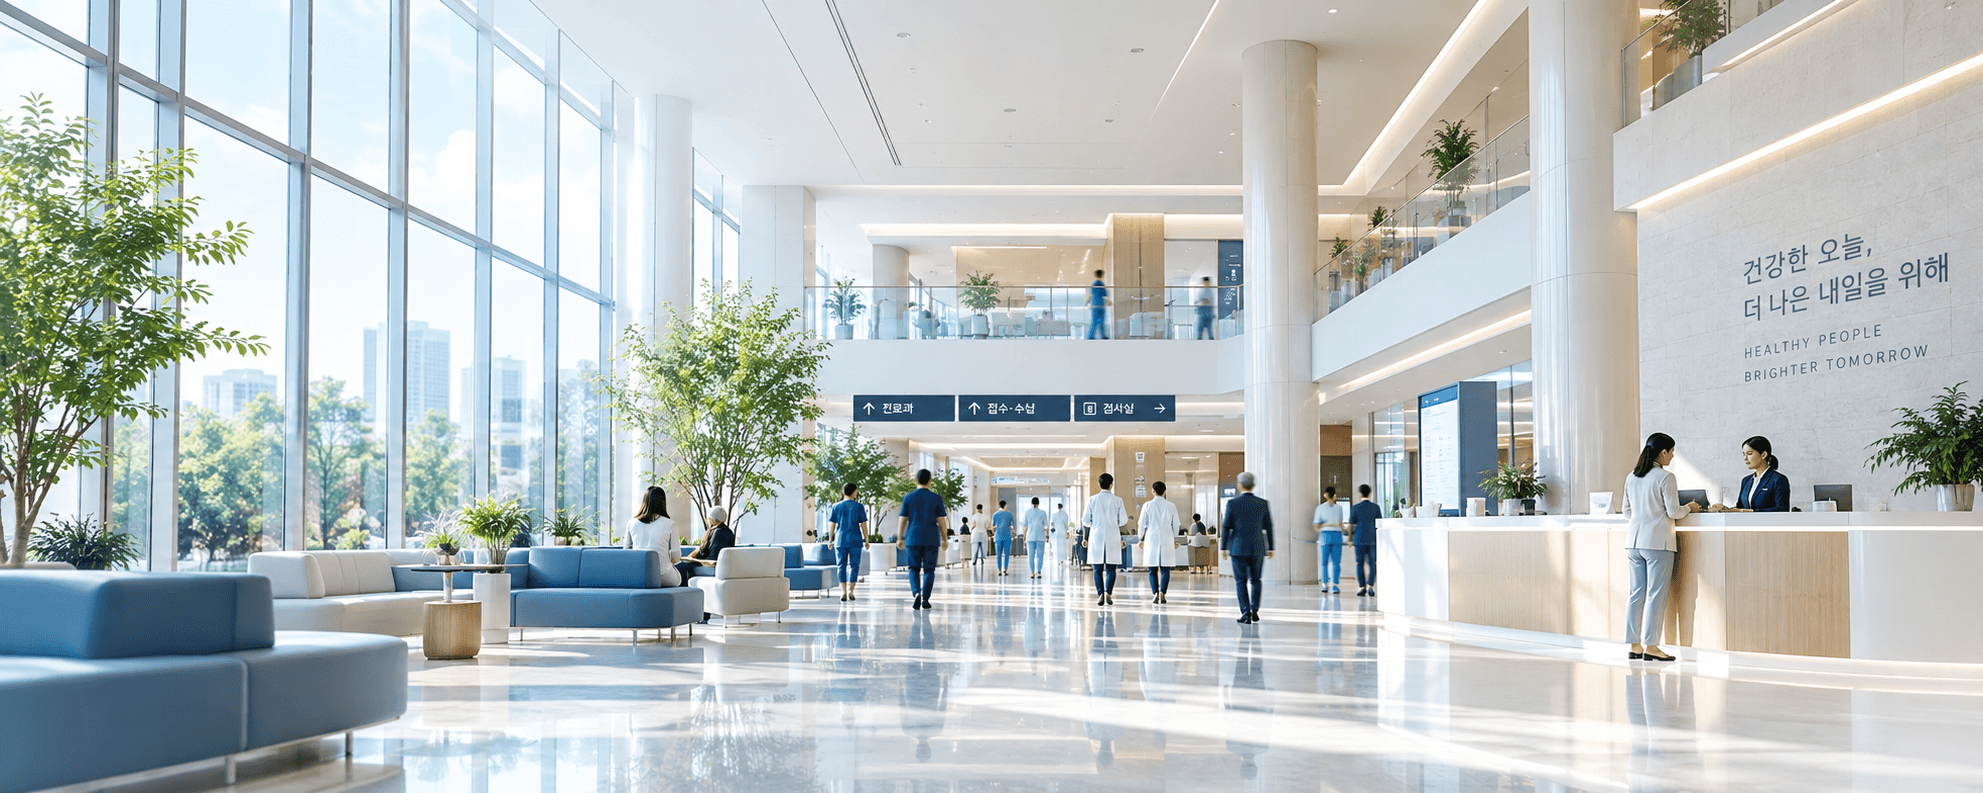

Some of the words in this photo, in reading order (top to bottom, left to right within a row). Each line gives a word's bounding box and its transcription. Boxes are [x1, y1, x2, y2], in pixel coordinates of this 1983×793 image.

[1743, 244, 1808, 285] 건강한
[1817, 233, 1872, 265] 오늘,
[1744, 294, 1761, 321] 더
[1769, 285, 1810, 316] 나은
[1819, 267, 1889, 304] 내일을
[1897, 252, 1949, 290] 위해
[1744, 337, 1810, 359] HEALTHY
[1818, 324, 1882, 347] PEOPLE
[1744, 360, 1818, 382] BRIGHTER
[1826, 344, 1929, 371] TOMORROW
